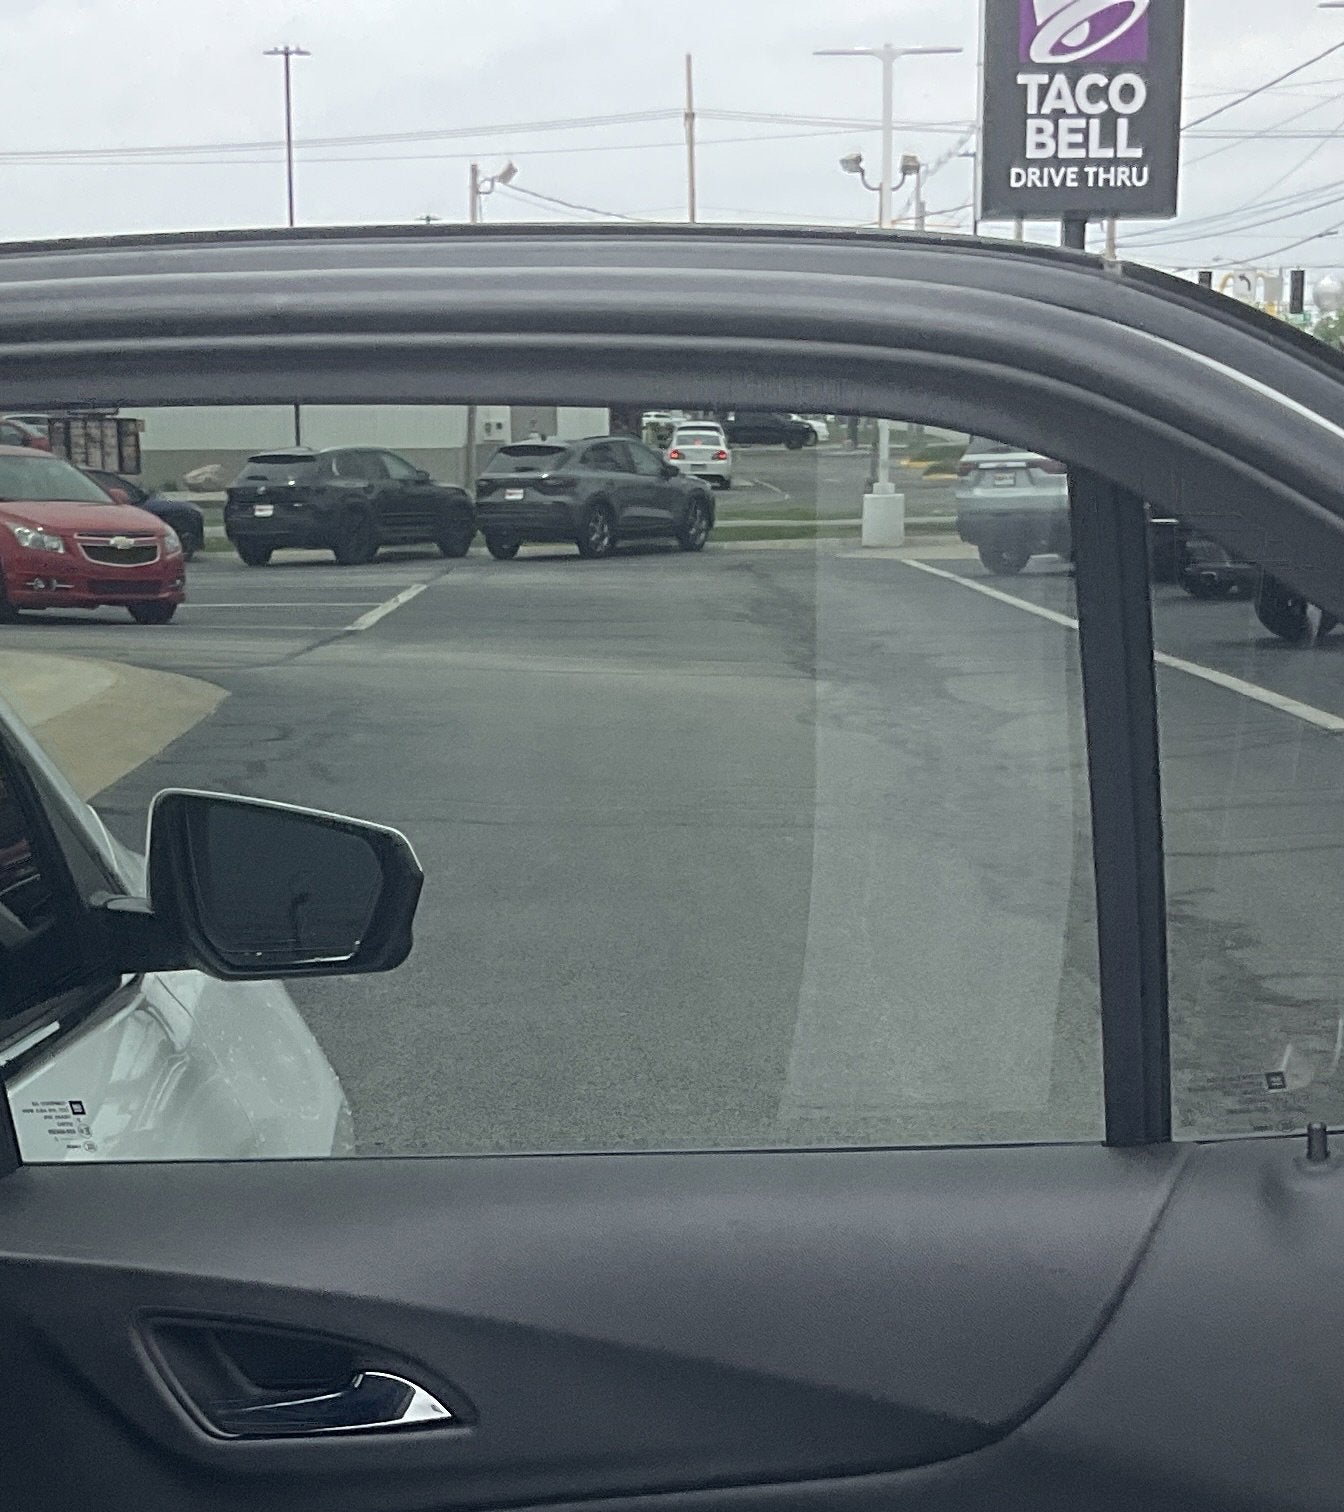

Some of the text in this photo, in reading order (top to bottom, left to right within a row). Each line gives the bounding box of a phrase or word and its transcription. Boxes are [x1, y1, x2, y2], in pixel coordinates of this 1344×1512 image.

[1016, 72, 1148, 115] TACO
[1025, 117, 1144, 159] BELL
[1009, 165, 1150, 188] DRIVE THRU
